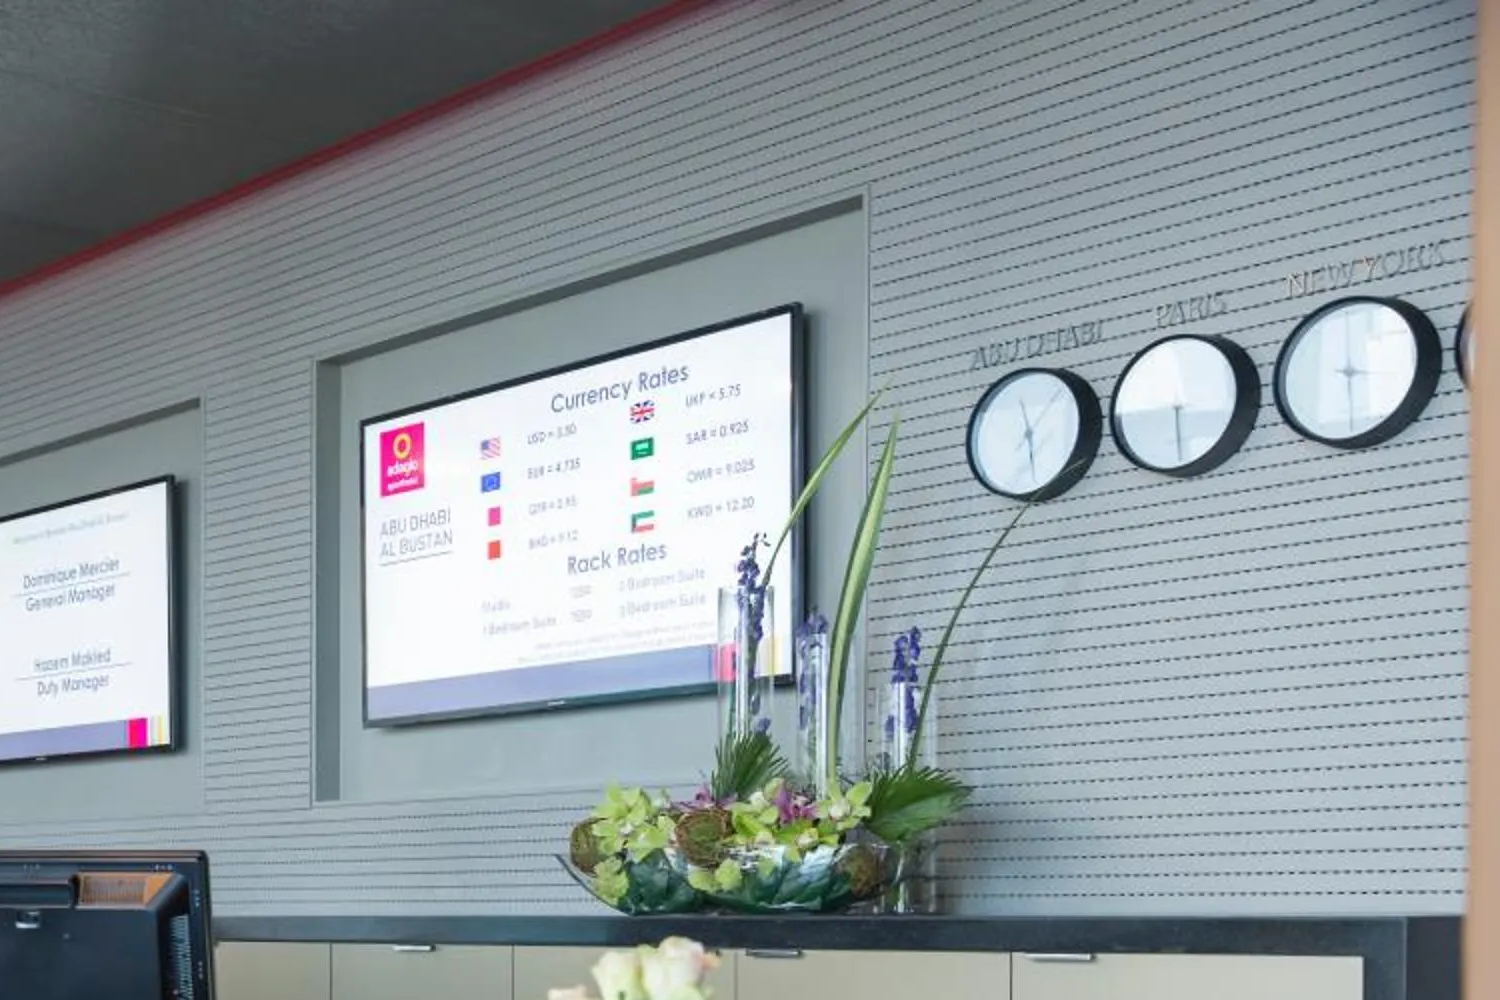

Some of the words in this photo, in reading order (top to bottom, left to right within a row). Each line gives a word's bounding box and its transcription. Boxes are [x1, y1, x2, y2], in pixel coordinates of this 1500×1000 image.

[1285, 263, 1351, 298] NEW
[1155, 291, 1226, 328] PARIS
[970, 338, 1018, 369] ABU
[1026, 320, 1102, 358] DHABI
[551, 379, 632, 413] Currency
[638, 366, 689, 392] Rates
[381, 517, 407, 535] ABU
[410, 506, 451, 531] DHABI
[381, 541, 396, 556] AL
[400, 528, 453, 554] BUSTAN
[567, 550, 611, 574] Rack
[617, 543, 667, 566] Rates
[26, 592, 65, 612] General
[67, 584, 115, 604] Manager
[37, 680, 58, 697] Duty
[61, 675, 109, 693] Manager
